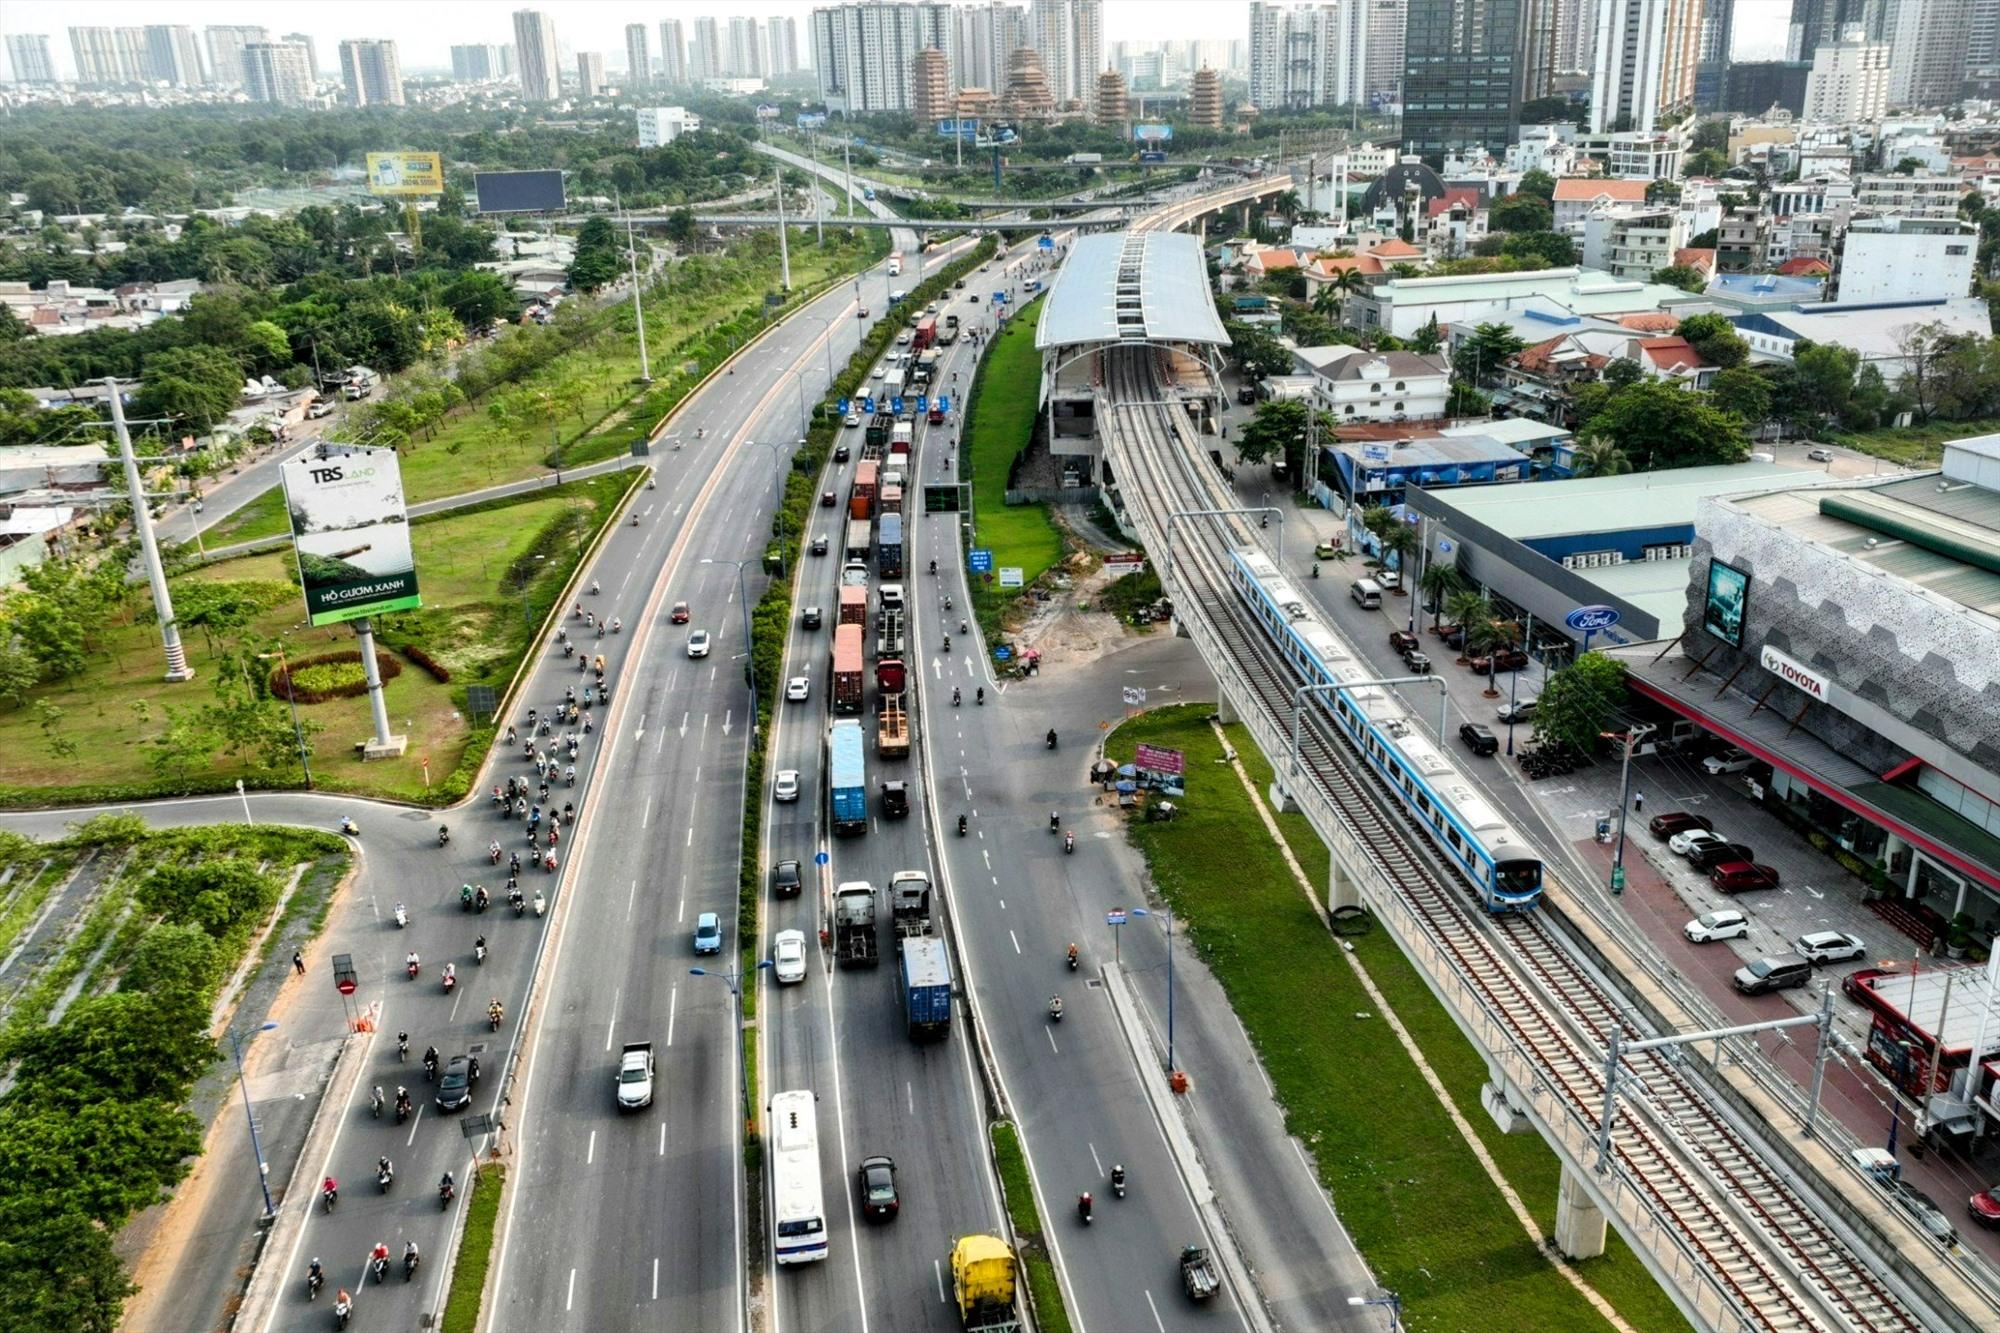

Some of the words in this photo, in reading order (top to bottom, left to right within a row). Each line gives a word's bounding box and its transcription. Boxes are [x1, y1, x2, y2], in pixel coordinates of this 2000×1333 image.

[309, 466, 343, 484] TBS
[374, 579, 404, 593] XANH
[1579, 611, 1611, 627] Ford
[1781, 662, 1822, 697] TOYOTA
